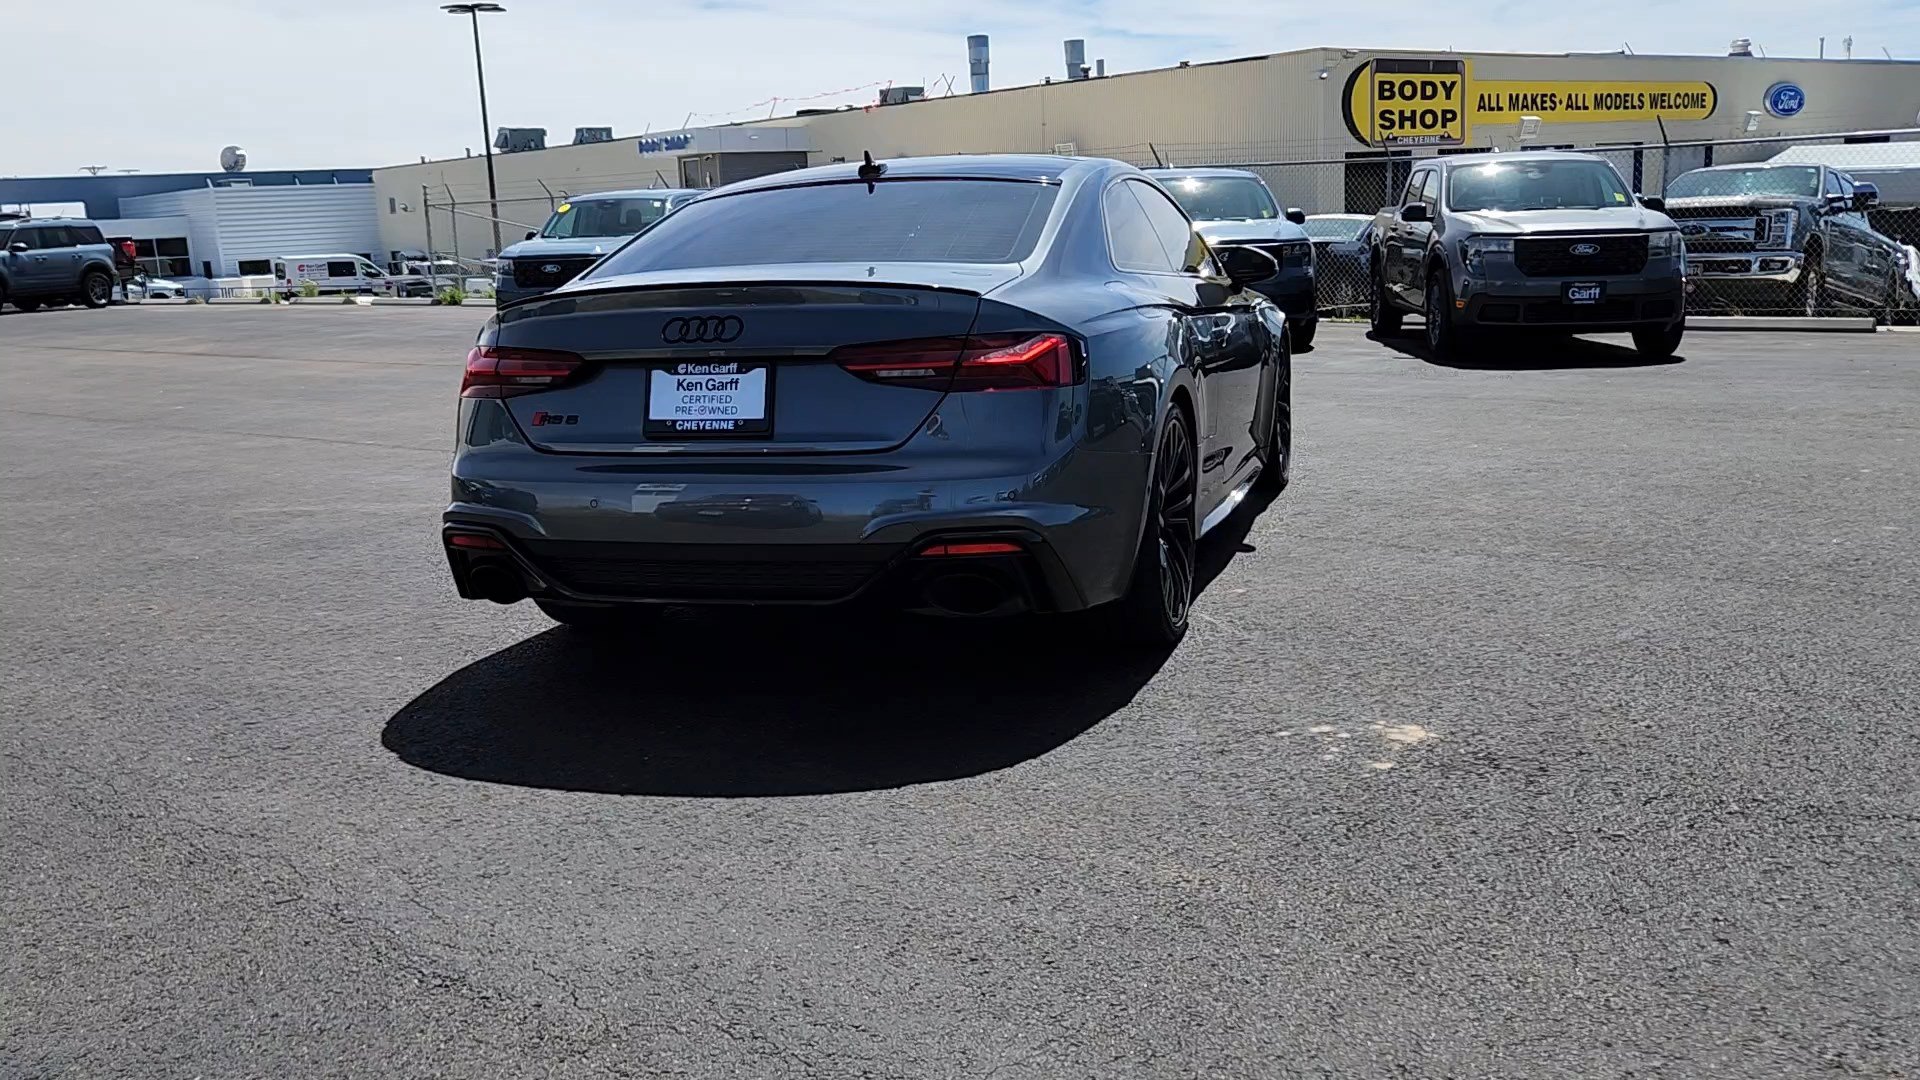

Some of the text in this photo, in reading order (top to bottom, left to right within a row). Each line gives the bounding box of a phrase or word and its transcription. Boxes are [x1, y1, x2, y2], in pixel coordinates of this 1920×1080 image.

[1378, 79, 1458, 102] BODY
[1476, 92, 1707, 112] ALL MAKES ALL MODELS WELCOME
[1778, 90, 1801, 109] Ford
[1378, 108, 1458, 130] SHOP
[1396, 136, 1441, 145] CHEYENNE
[1574, 243, 1595, 254] Ford
[1568, 287, 1601, 299] Garff
[687, 362, 738, 374] Ken Garff
[676, 377, 740, 392] Ken Garff
[681, 394, 733, 404] CERTIFIED
[675, 420, 735, 430] CHEYENNE
